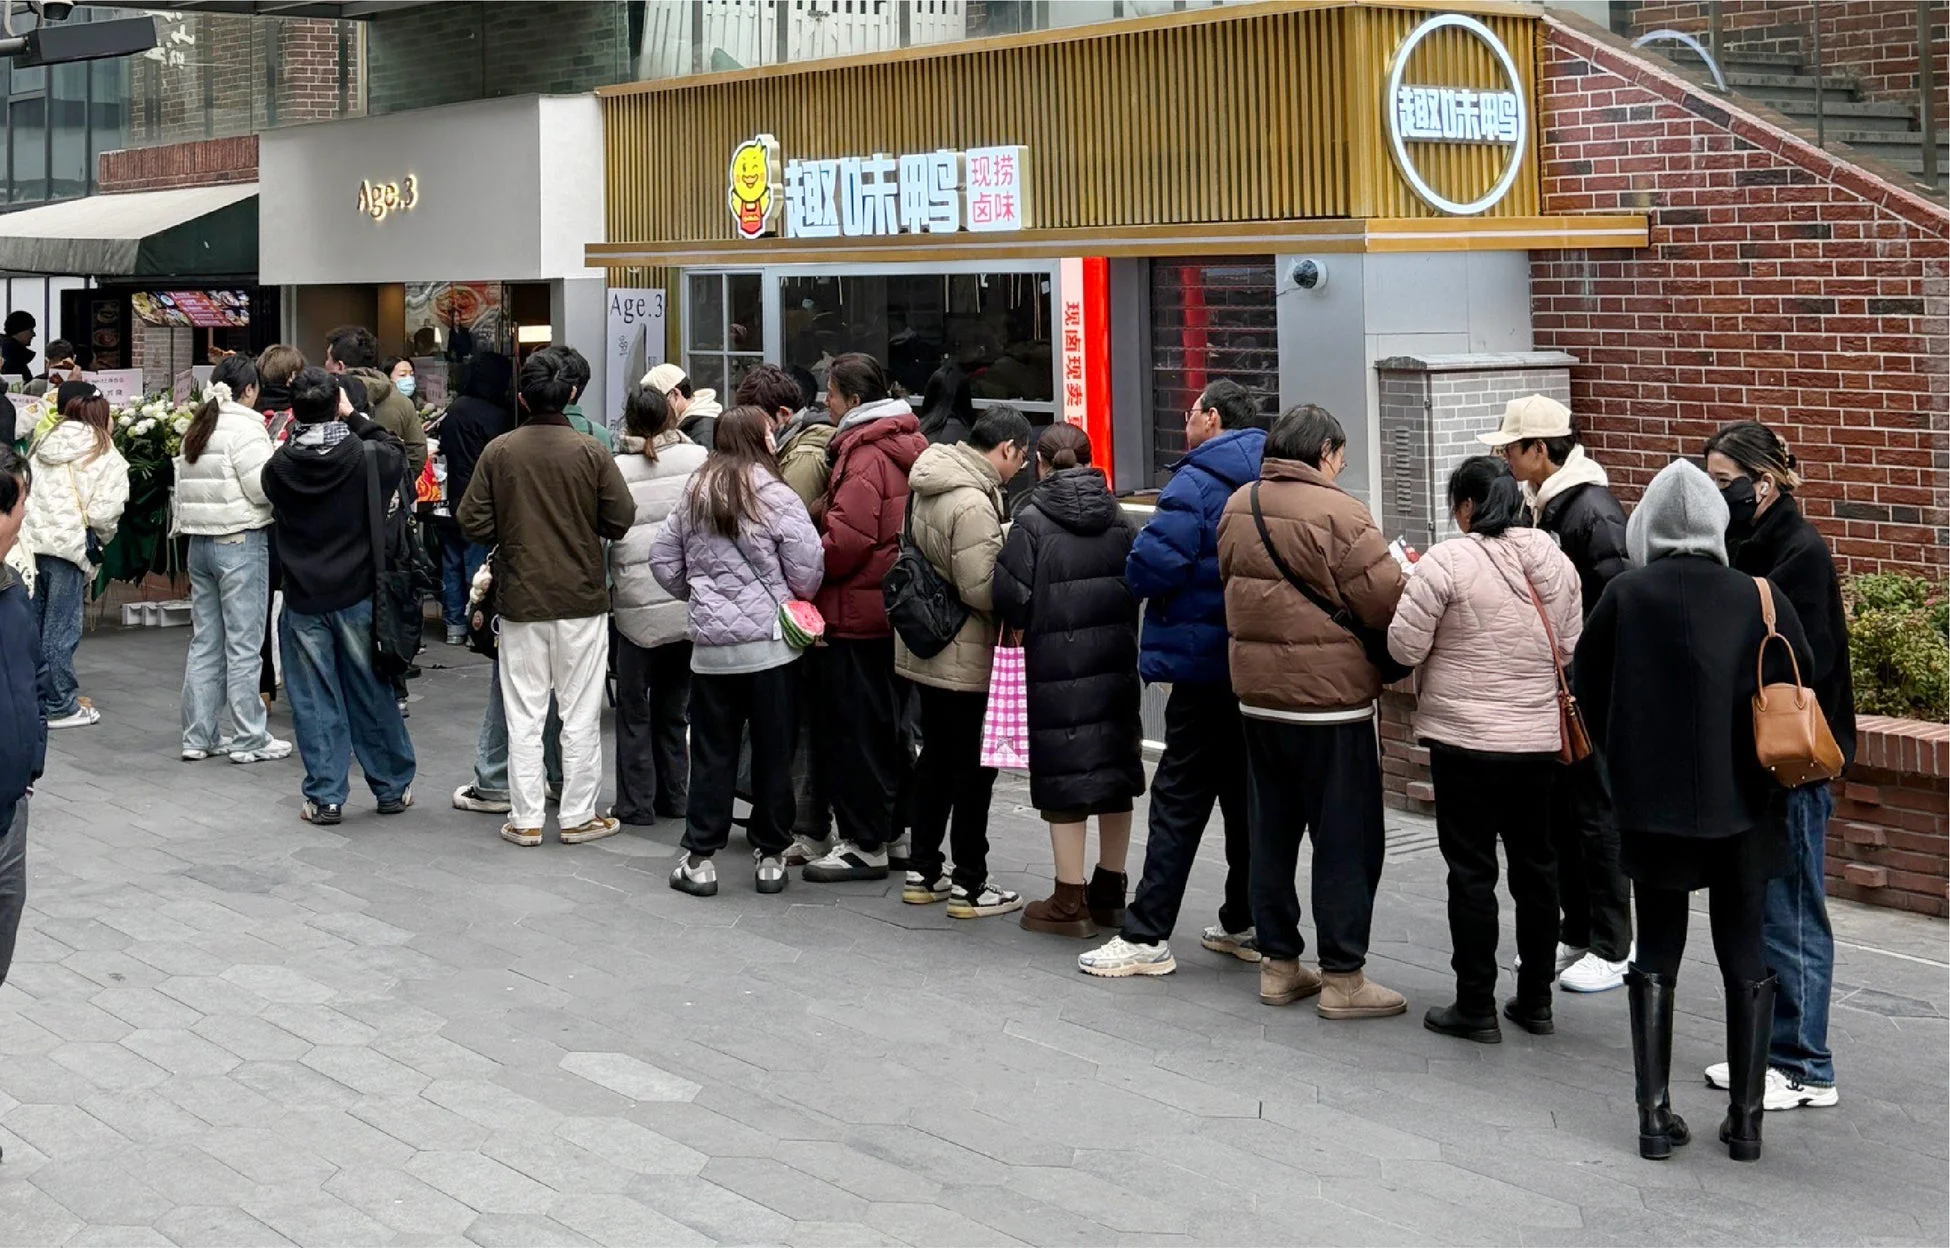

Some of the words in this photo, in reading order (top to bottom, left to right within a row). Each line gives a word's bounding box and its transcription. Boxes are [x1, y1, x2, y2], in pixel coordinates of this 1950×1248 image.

[1398, 86, 1518, 142] 趣味鸭
[971, 155, 1014, 185] 现捞
[357, 174, 418, 220] Age.3
[785, 150, 959, 238] 趣味鸭
[973, 191, 1015, 223] 卤味
[610, 293, 663, 324] Age.3
